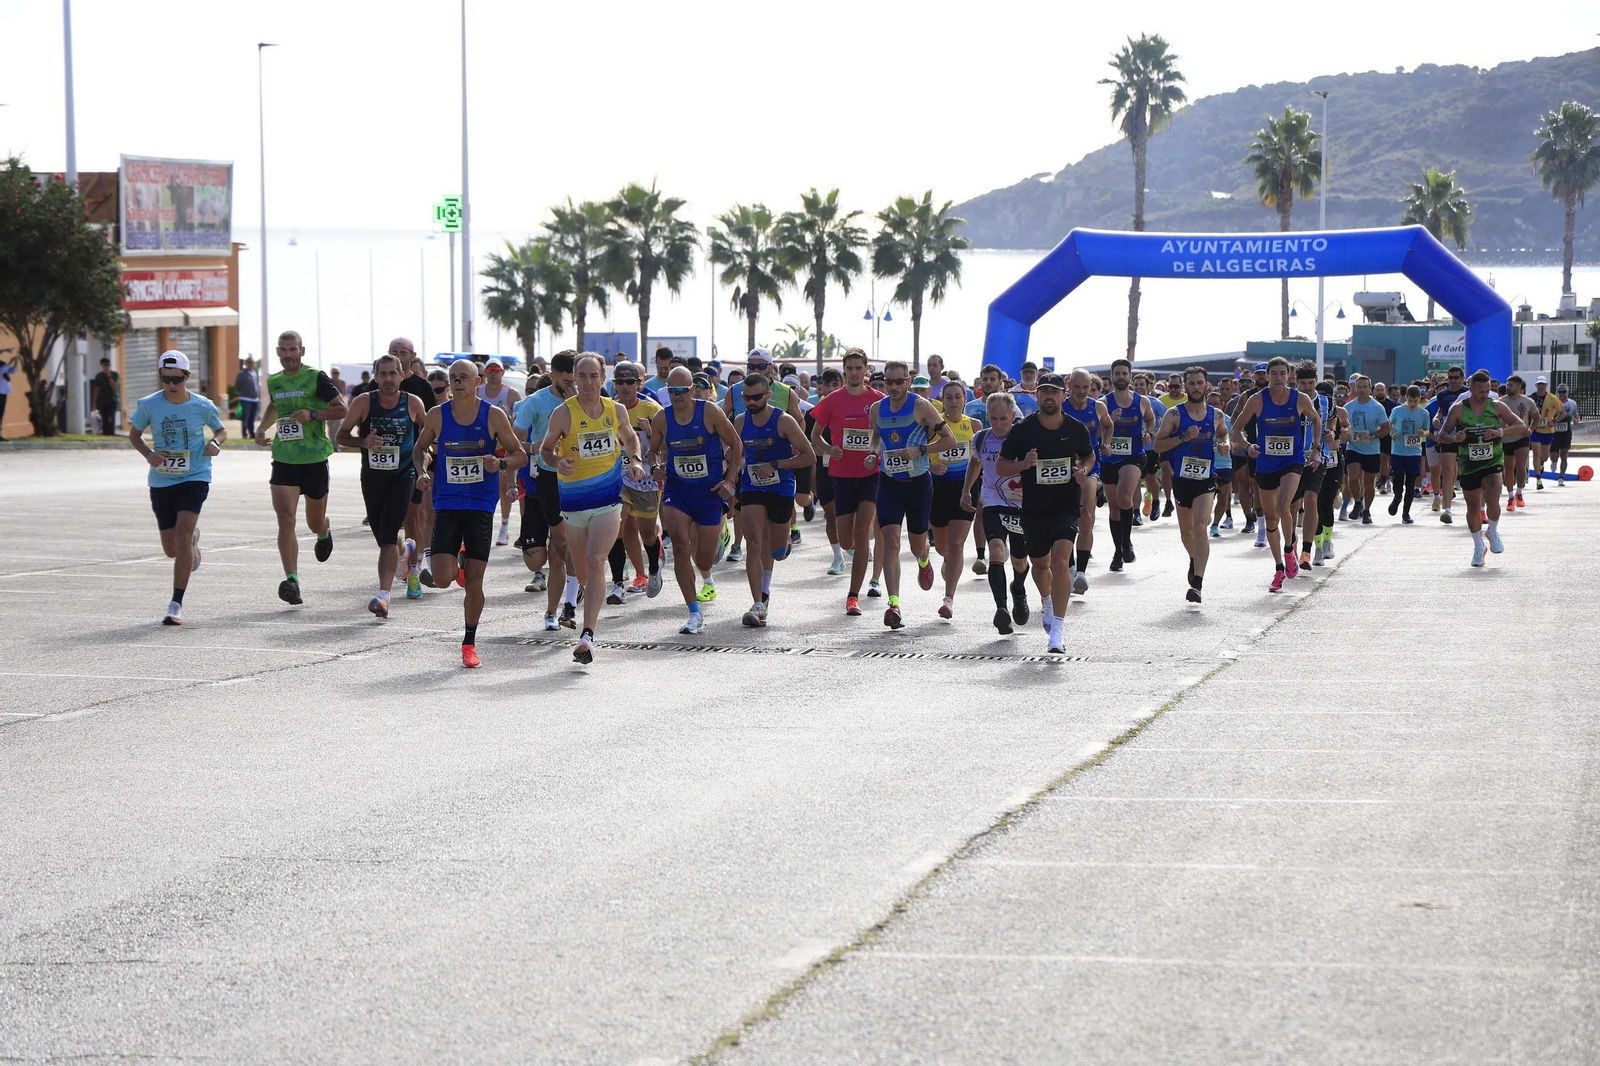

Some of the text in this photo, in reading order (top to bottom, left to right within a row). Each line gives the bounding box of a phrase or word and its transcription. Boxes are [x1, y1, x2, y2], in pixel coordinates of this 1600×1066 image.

[1161, 238, 1328, 254] AYUNTAMIENTO
[1173, 257, 1316, 273] DE ALGECIRAS
[279, 424, 299, 434] 469
[583, 437, 611, 451] 441
[846, 435, 869, 445] 302
[1268, 442, 1290, 450] 308
[943, 448, 966, 458] 387
[1471, 448, 1491, 456] 337
[371, 453, 395, 463] 381
[886, 457, 909, 467] 495
[450, 465, 480, 476] 314
[678, 462, 704, 473] 100
[1041, 466, 1068, 477] 225
[1185, 463, 1207, 474] 257
[1002, 515, 1021, 526] 45
